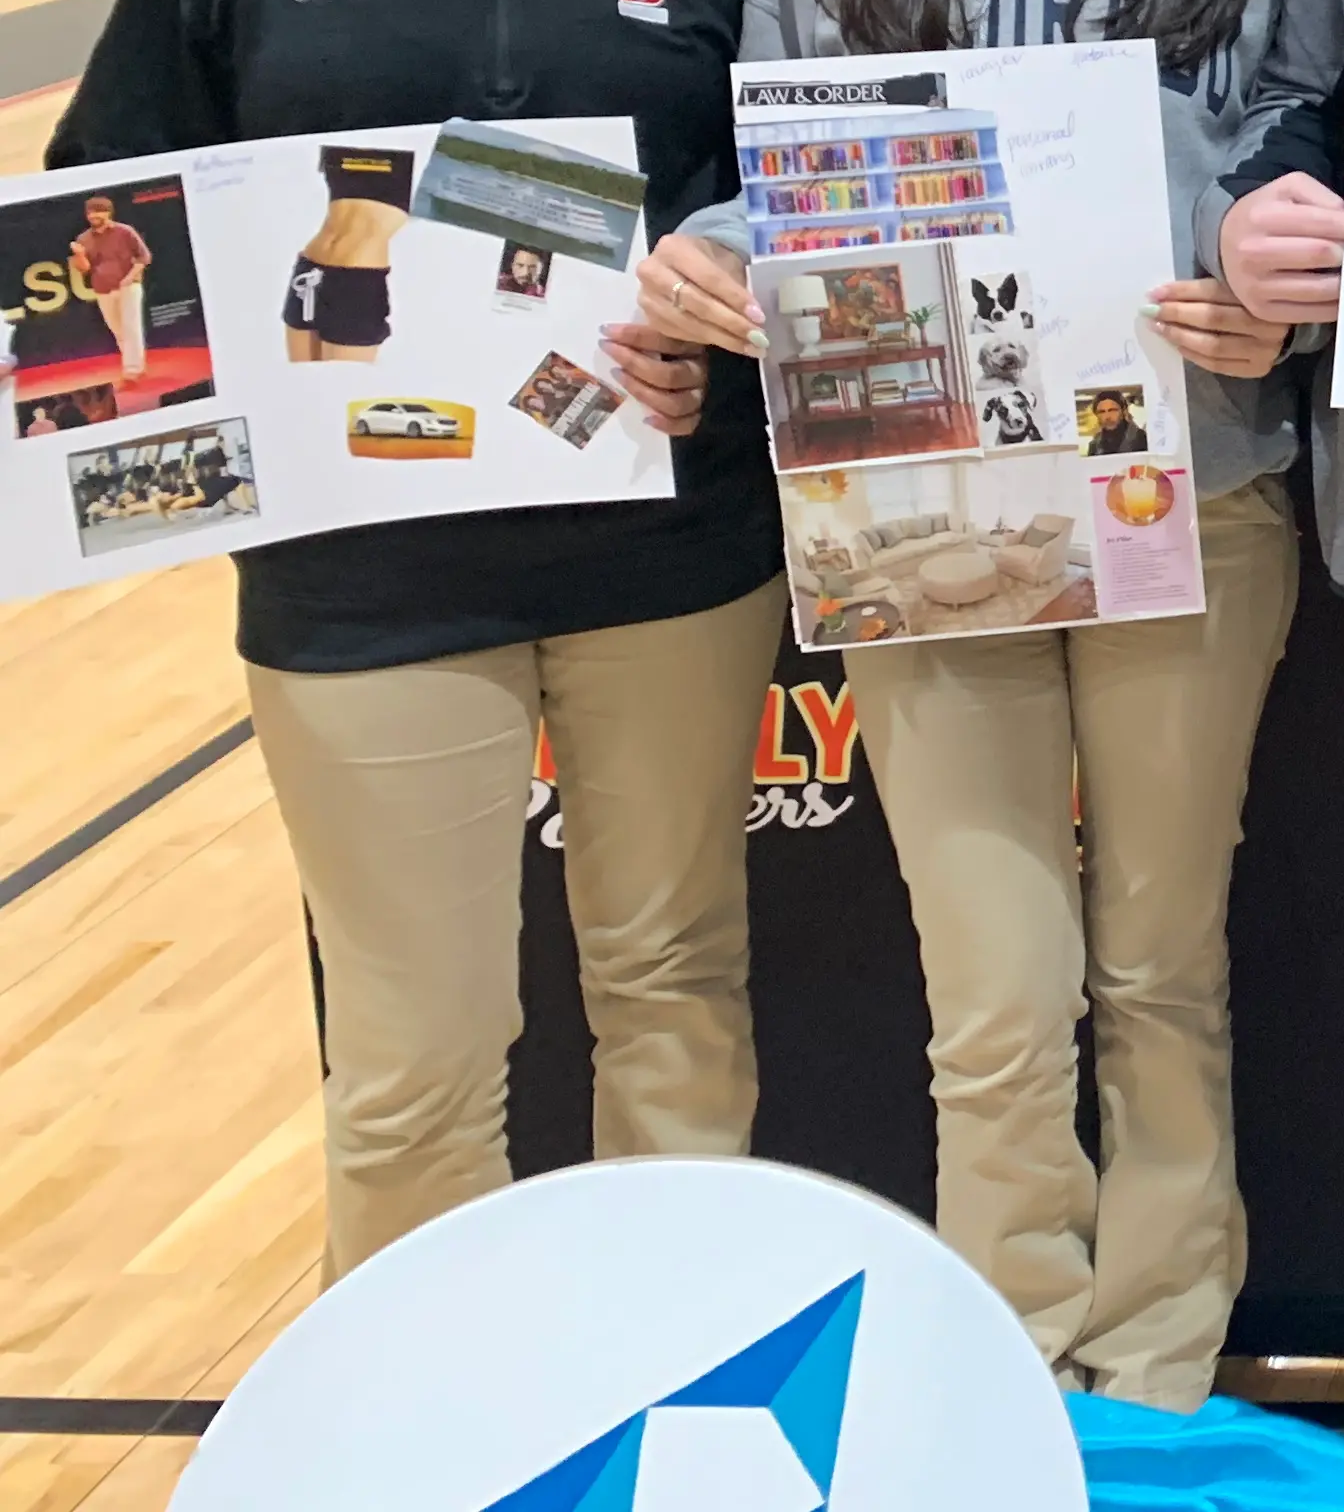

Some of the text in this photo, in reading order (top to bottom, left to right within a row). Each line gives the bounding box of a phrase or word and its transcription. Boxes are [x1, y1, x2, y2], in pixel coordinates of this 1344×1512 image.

[743, 83, 886, 106] LAW & ORDER
